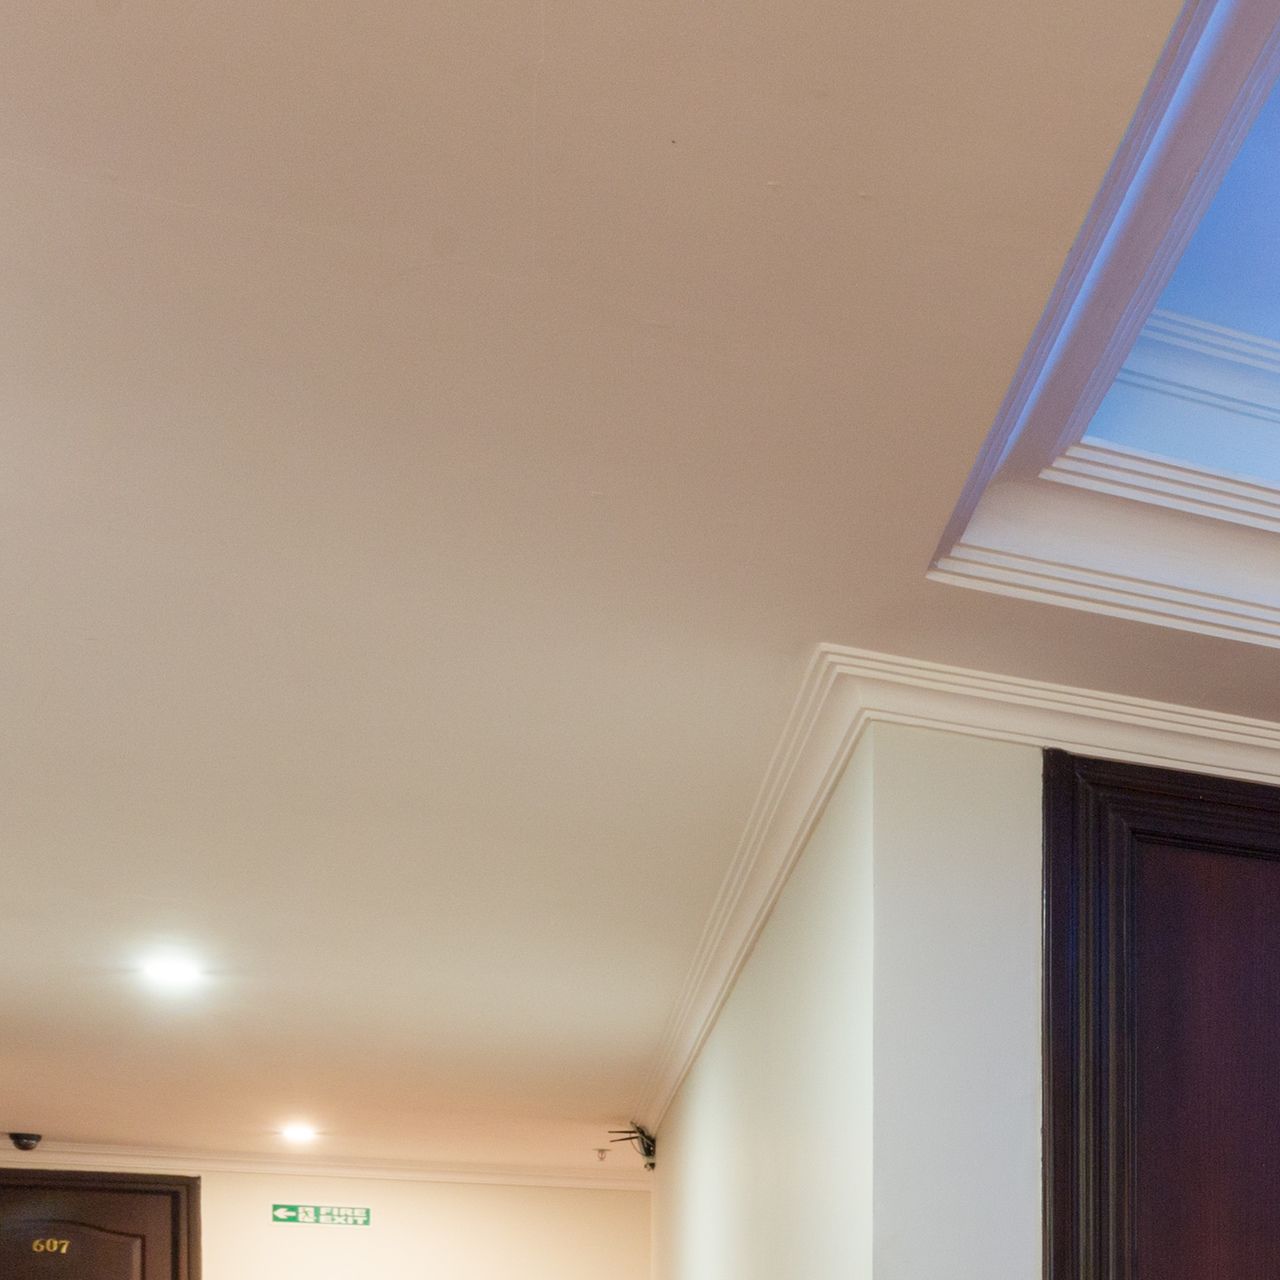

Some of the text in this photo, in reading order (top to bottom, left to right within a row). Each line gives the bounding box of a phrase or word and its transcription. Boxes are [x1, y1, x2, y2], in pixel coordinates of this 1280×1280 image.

[320, 1206, 366, 1217] FIRE
[320, 1215, 367, 1225] EXIT
[32, 1238, 70, 1254] 607
